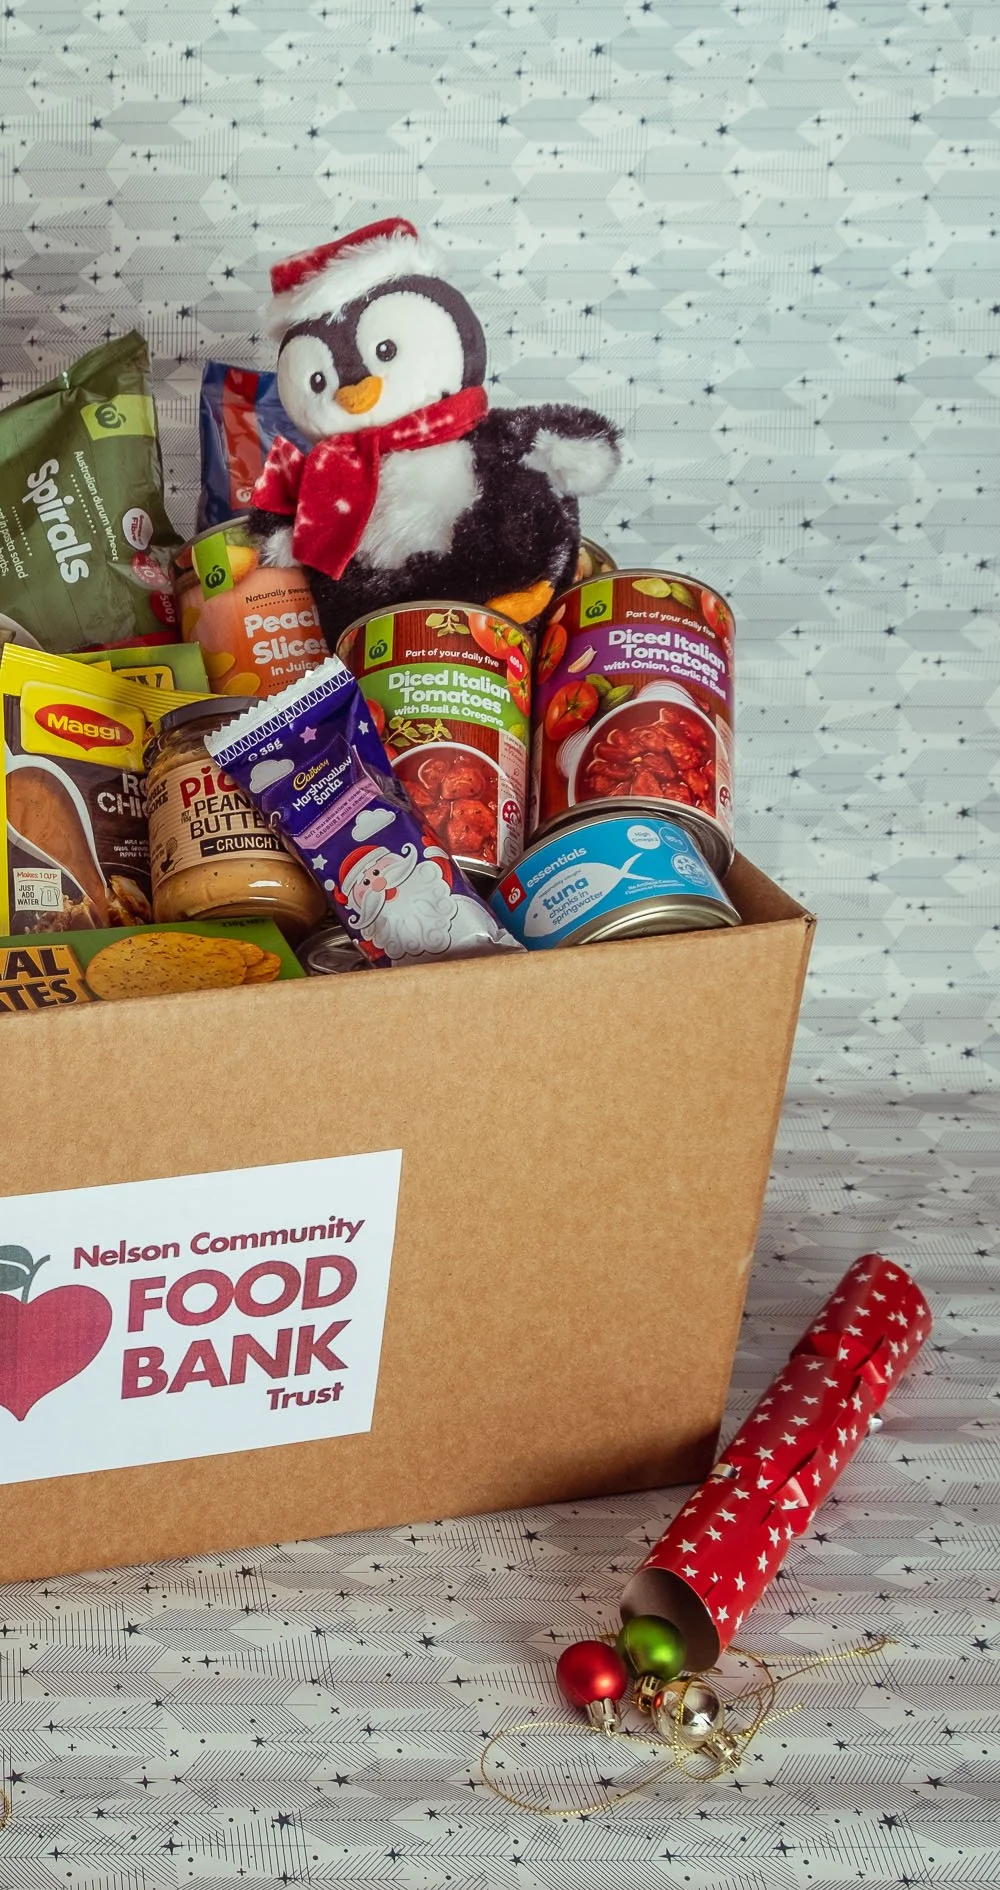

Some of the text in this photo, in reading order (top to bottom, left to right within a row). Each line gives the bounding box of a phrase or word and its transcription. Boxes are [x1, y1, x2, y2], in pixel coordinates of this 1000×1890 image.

[74, 450, 119, 561] Australian durum wheat
[0, 519, 8, 529] in
[0, 528, 15, 551] pasta
[10, 552, 29, 579] salad
[245, 589, 286, 603] Naturally
[625, 610, 647, 618] Part
[649, 611, 660, 619] of
[661, 614, 681, 624] your
[682, 618, 702, 632] daily
[406, 648, 499, 668] Part of your daily five
[608, 629, 671, 646] Diced
[674, 634, 726, 674] Italian
[621, 644, 719, 681] Tomatoes
[271, 666, 284, 676] in
[603, 660, 630, 671] with
[632, 660, 669, 673] Onion,
[671, 665, 701, 681] Garlic
[701, 675, 709, 686] &
[388, 670, 511, 702] Diced Italian
[400, 687, 502, 713] Tomatoes
[47, 713, 121, 741] Maggi
[394, 704, 504, 727] with Basil & Oregano
[260, 738, 283, 755] 35g
[292, 756, 352, 811] Marshmallow
[293, 758, 330, 791] Cadbury
[313, 780, 344, 805] Santa
[190, 811, 266, 840] BUTTE
[216, 837, 280, 851] CRUNCHY
[527, 847, 587, 888] essentials
[543, 877, 589, 910] tuna
[549, 890, 589, 918] chunks in
[552, 891, 603, 925] springwater
[73, 1215, 365, 1269] Nelson Community
[127, 1254, 358, 1333] FOOD
[120, 1319, 352, 1399] BANK
[266, 1382, 344, 1410] Trust
